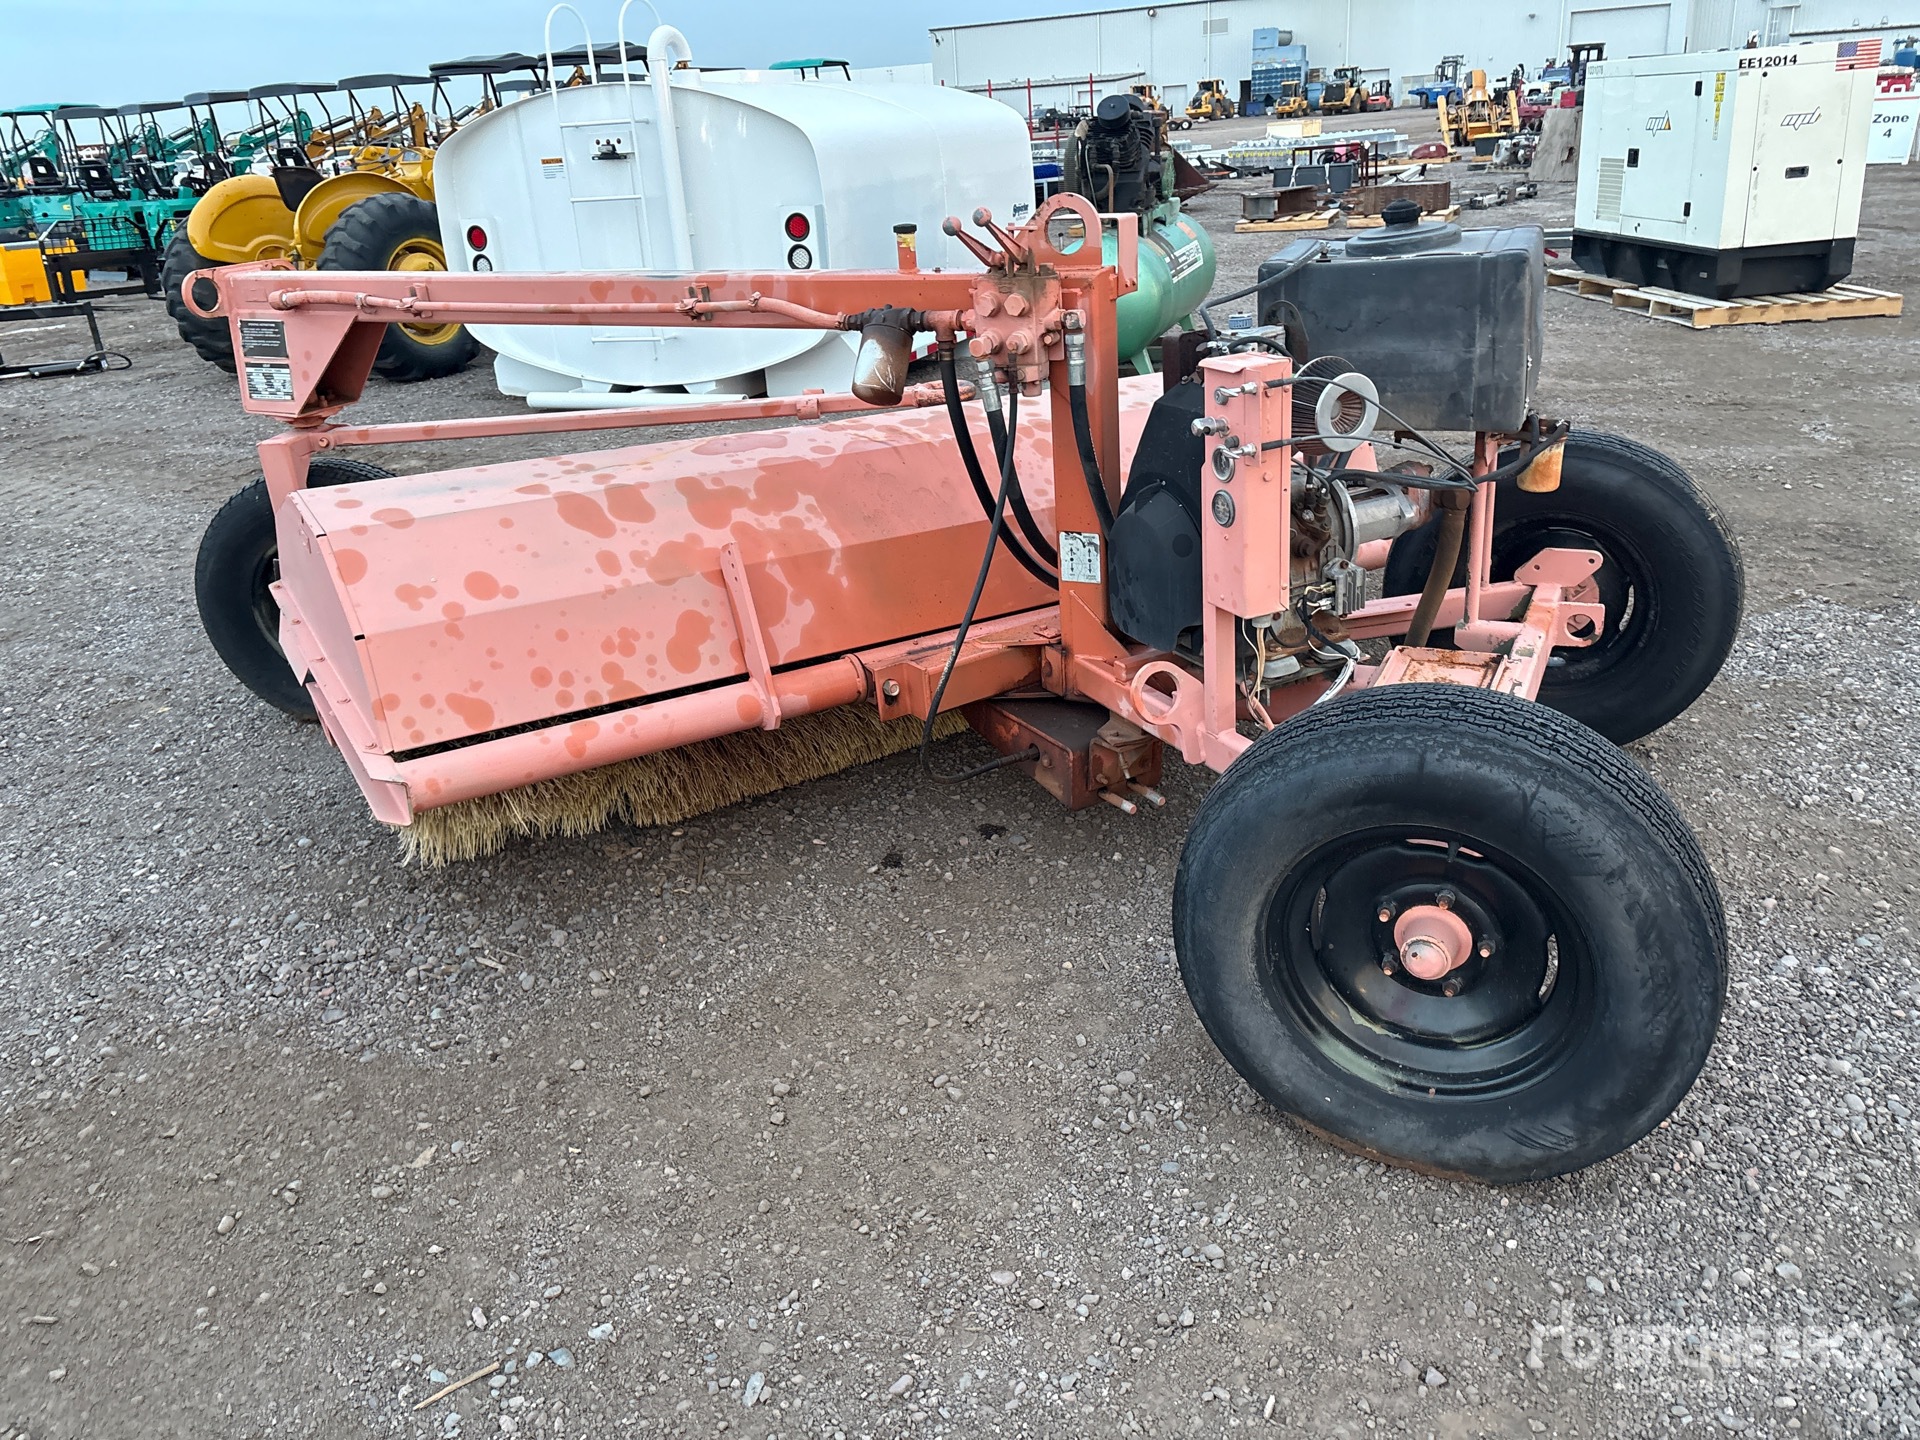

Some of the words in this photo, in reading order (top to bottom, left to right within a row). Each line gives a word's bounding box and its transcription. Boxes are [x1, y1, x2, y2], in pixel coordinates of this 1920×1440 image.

[1738, 54, 1798, 70] EE12014
[1872, 113, 1910, 124] Zone
[1882, 128, 1892, 138] 4
